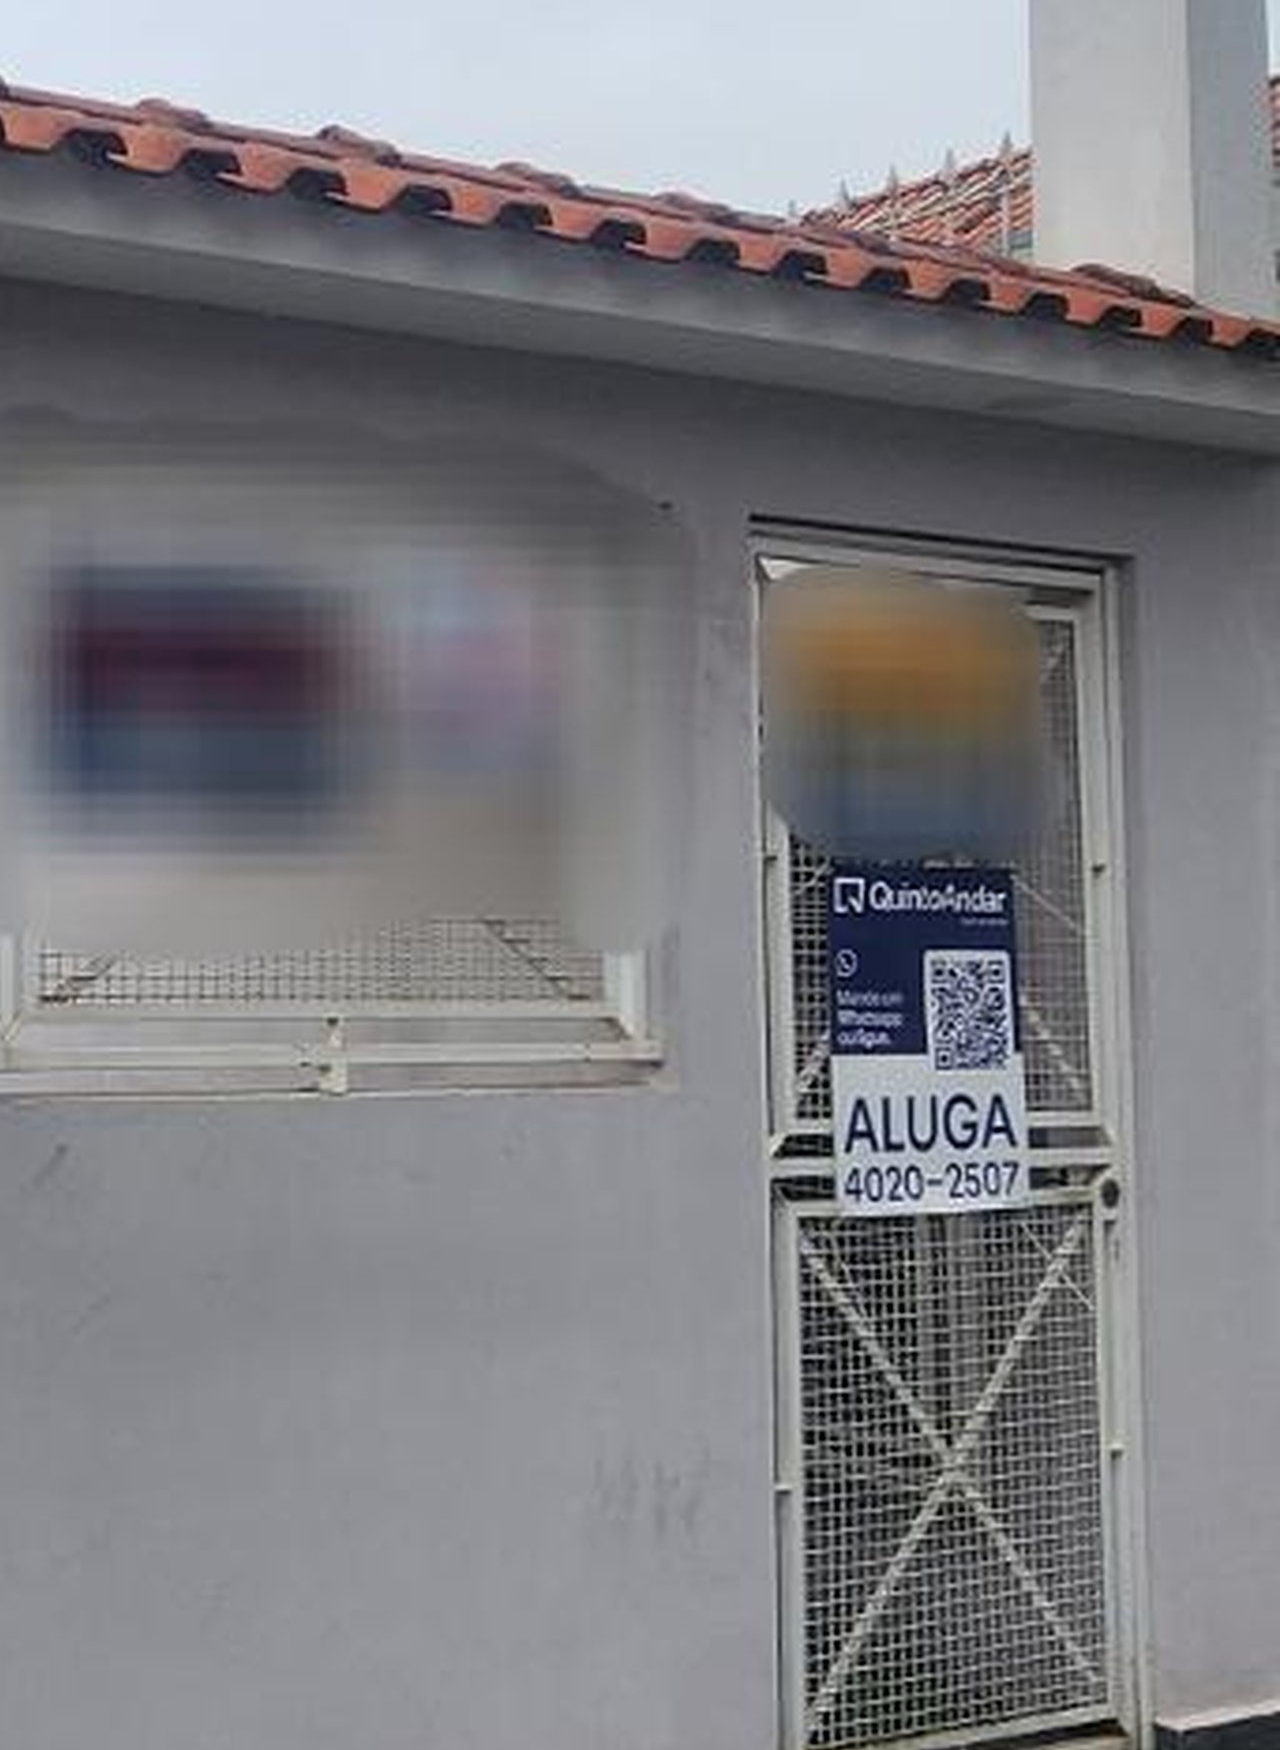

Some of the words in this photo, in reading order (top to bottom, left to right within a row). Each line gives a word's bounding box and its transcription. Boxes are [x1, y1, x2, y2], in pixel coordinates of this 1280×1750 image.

[869, 881, 1006, 913] QuintoAndar
[845, 1093, 1016, 1152] ALUGA
[844, 1161, 1019, 1203] 4020-2507
